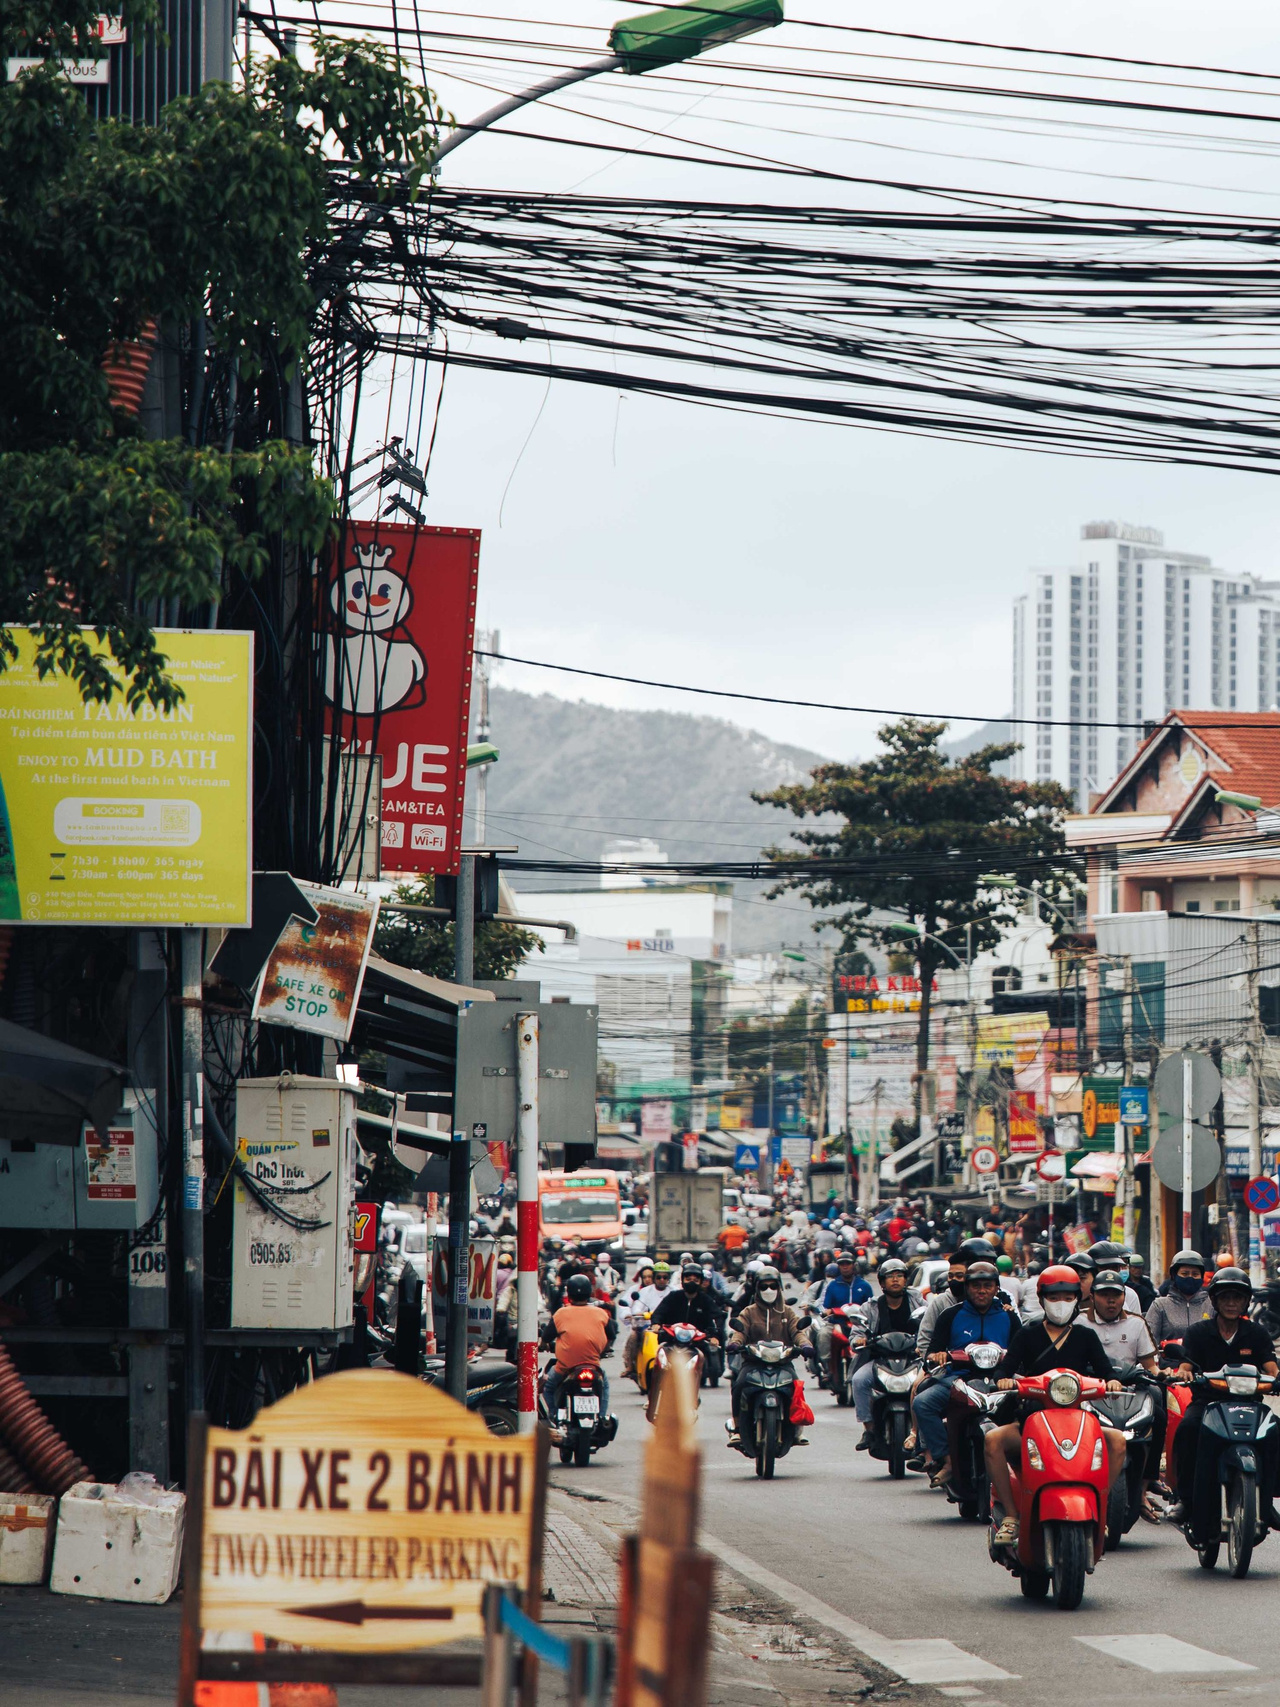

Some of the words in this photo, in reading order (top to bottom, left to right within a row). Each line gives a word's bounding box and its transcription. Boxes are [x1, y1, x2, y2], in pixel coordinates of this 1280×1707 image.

[208, 731, 236, 743] Nam
[18, 754, 58, 767] ENJOY
[62, 755, 80, 768] TO
[84, 747, 145, 768] MUD
[150, 749, 218, 770] BATH
[31, 773, 46, 784] At
[49, 773, 69, 784] the
[72, 773, 98, 785] first
[101, 774, 129, 785] mud
[132, 775, 160, 786] bath
[163, 776, 175, 786] in
[178, 776, 231, 788] Vietnam
[93, 806, 139, 816] BOOKING
[414, 834, 444, 848] Wi-Fi
[72, 855, 100, 866] 7h30
[155, 856, 175, 867] 365
[72, 869, 108, 880] 7:30am
[160, 870, 180, 880] 365
[181, 871, 205, 883] days
[643, 938, 674, 952] SHB
[275, 976, 305, 992] SAFE
[308, 983, 325, 997] XE
[328, 987, 347, 1004] OM
[285, 996, 329, 1019] STOP
[246, 1143, 272, 1157] QUÁN
[131, 1250, 167, 1274] 108
[211, 1435, 282, 1509] BÃI
[299, 1448, 351, 1510] XE
[366, 1450, 392, 1511] 2
[406, 1437, 523, 1513] BÁNH
[211, 1533, 270, 1578] TWO
[276, 1534, 400, 1581] WHEELER
[405, 1536, 521, 1581] PARKING
